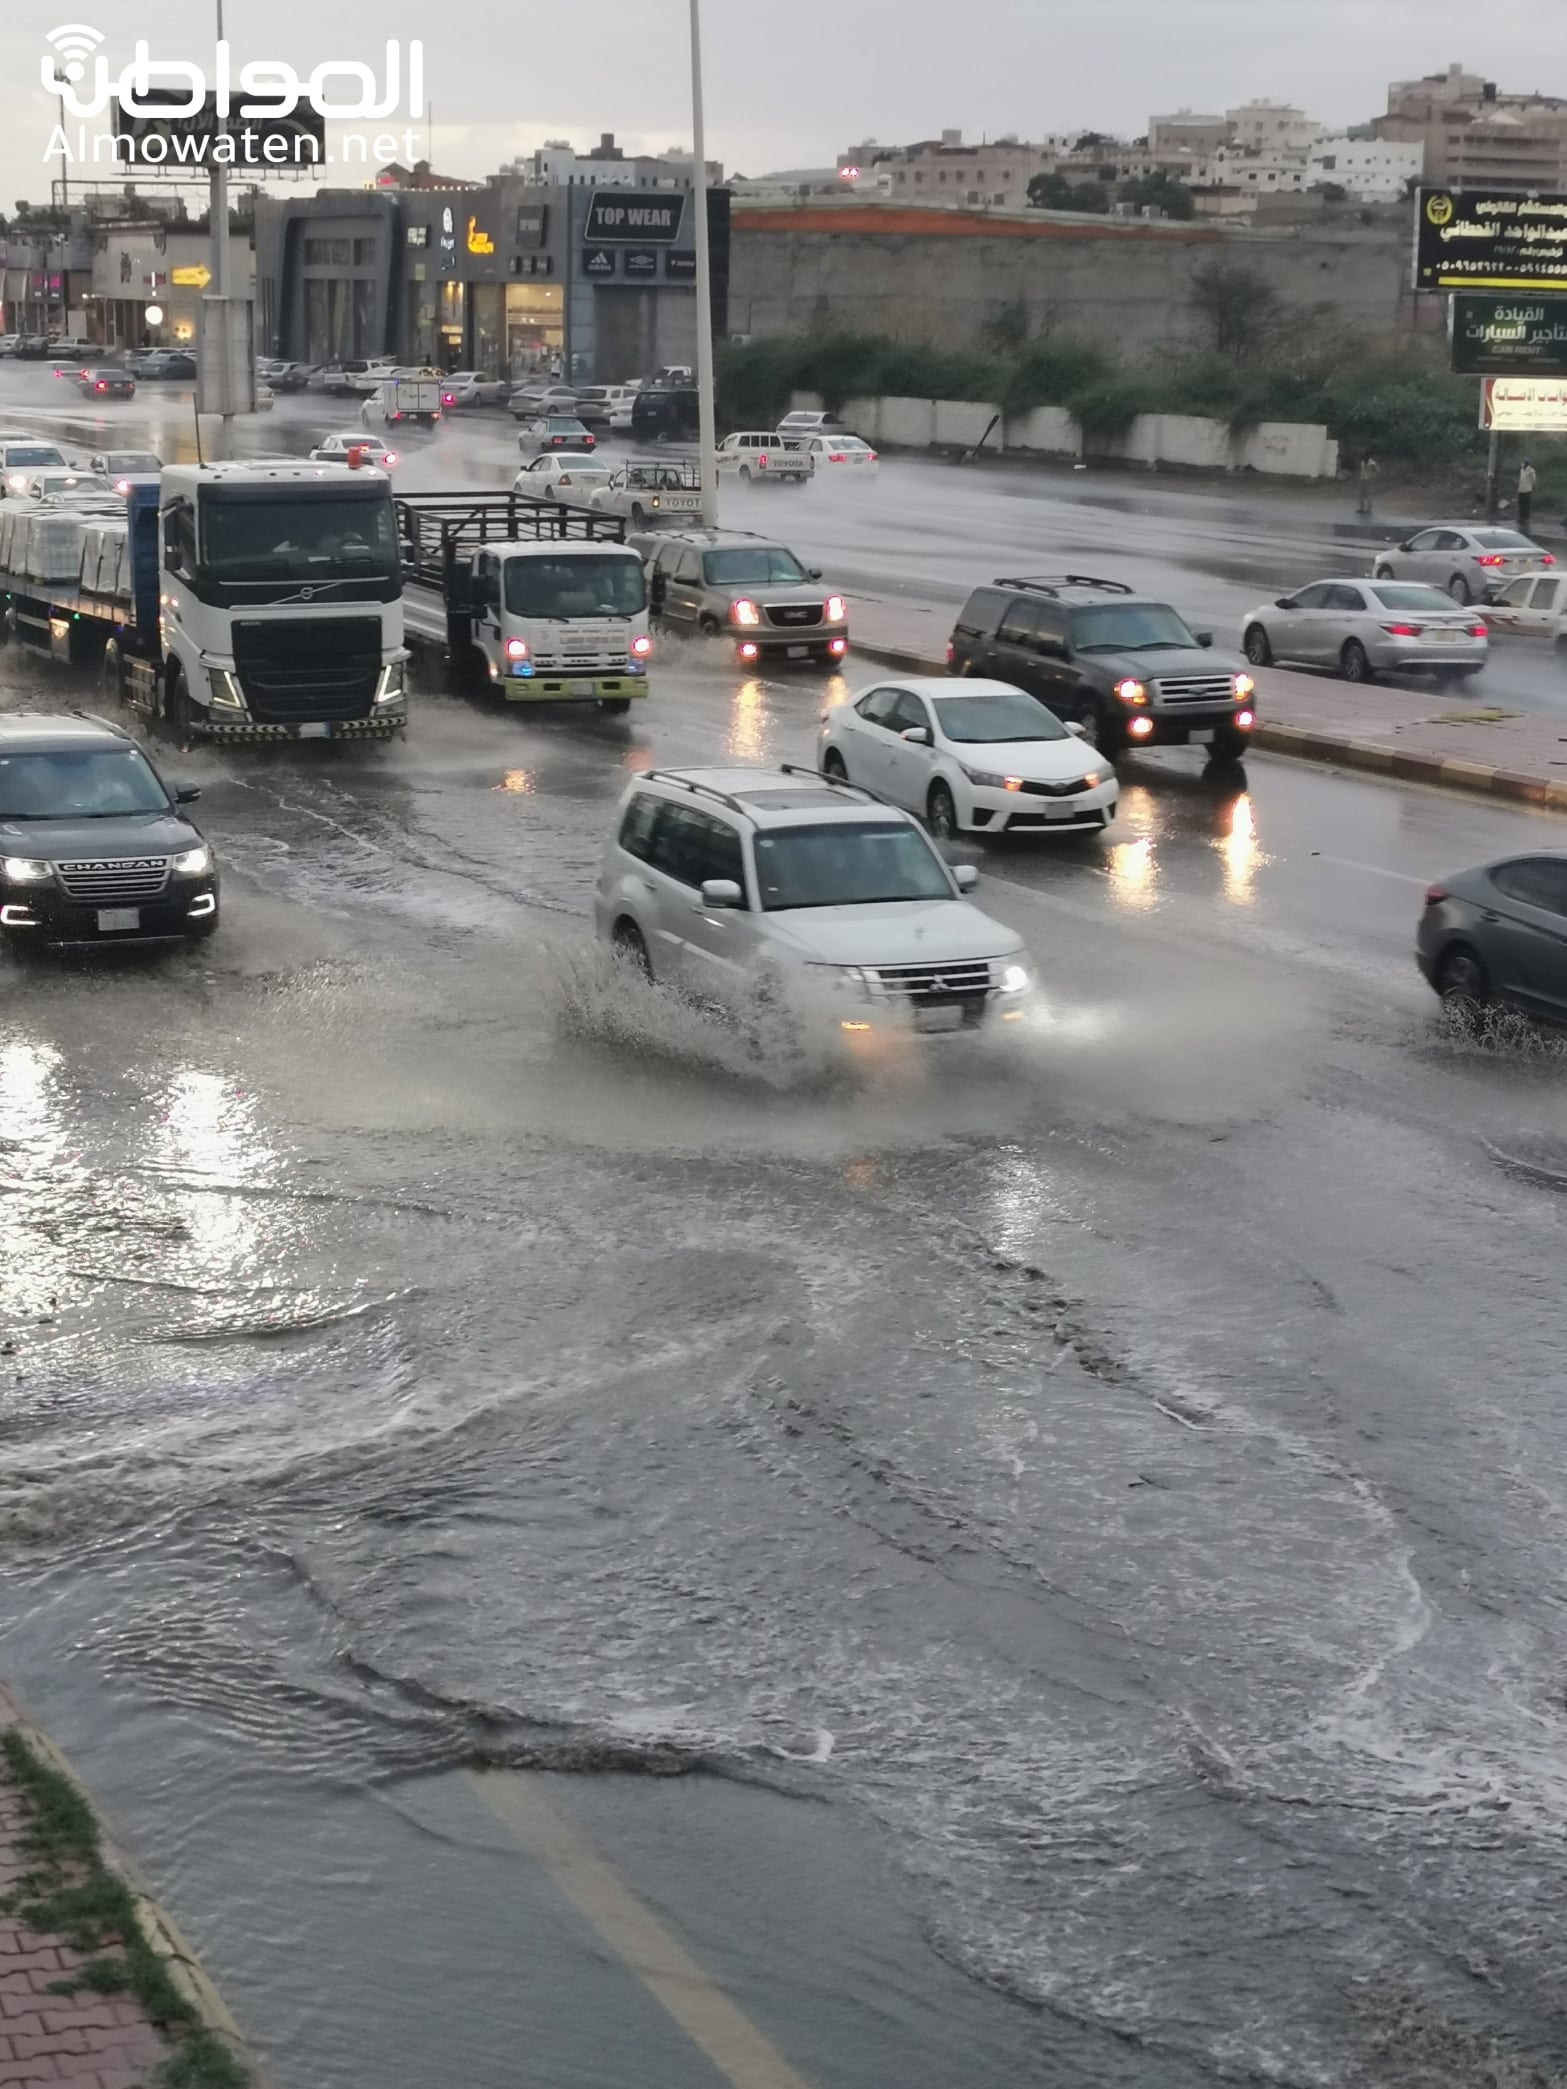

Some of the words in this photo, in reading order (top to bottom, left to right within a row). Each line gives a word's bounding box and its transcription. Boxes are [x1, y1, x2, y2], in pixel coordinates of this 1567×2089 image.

[595, 207, 625, 225] TOP
[627, 208, 672, 226] WEAR
[1494, 305, 1545, 325] القيادة
[1466, 323, 1527, 343] السيارات
[774, 459, 804, 468] TOYOTA
[665, 498, 701, 508] TOYOT
[62, 859, 164, 872] CHANGAN
